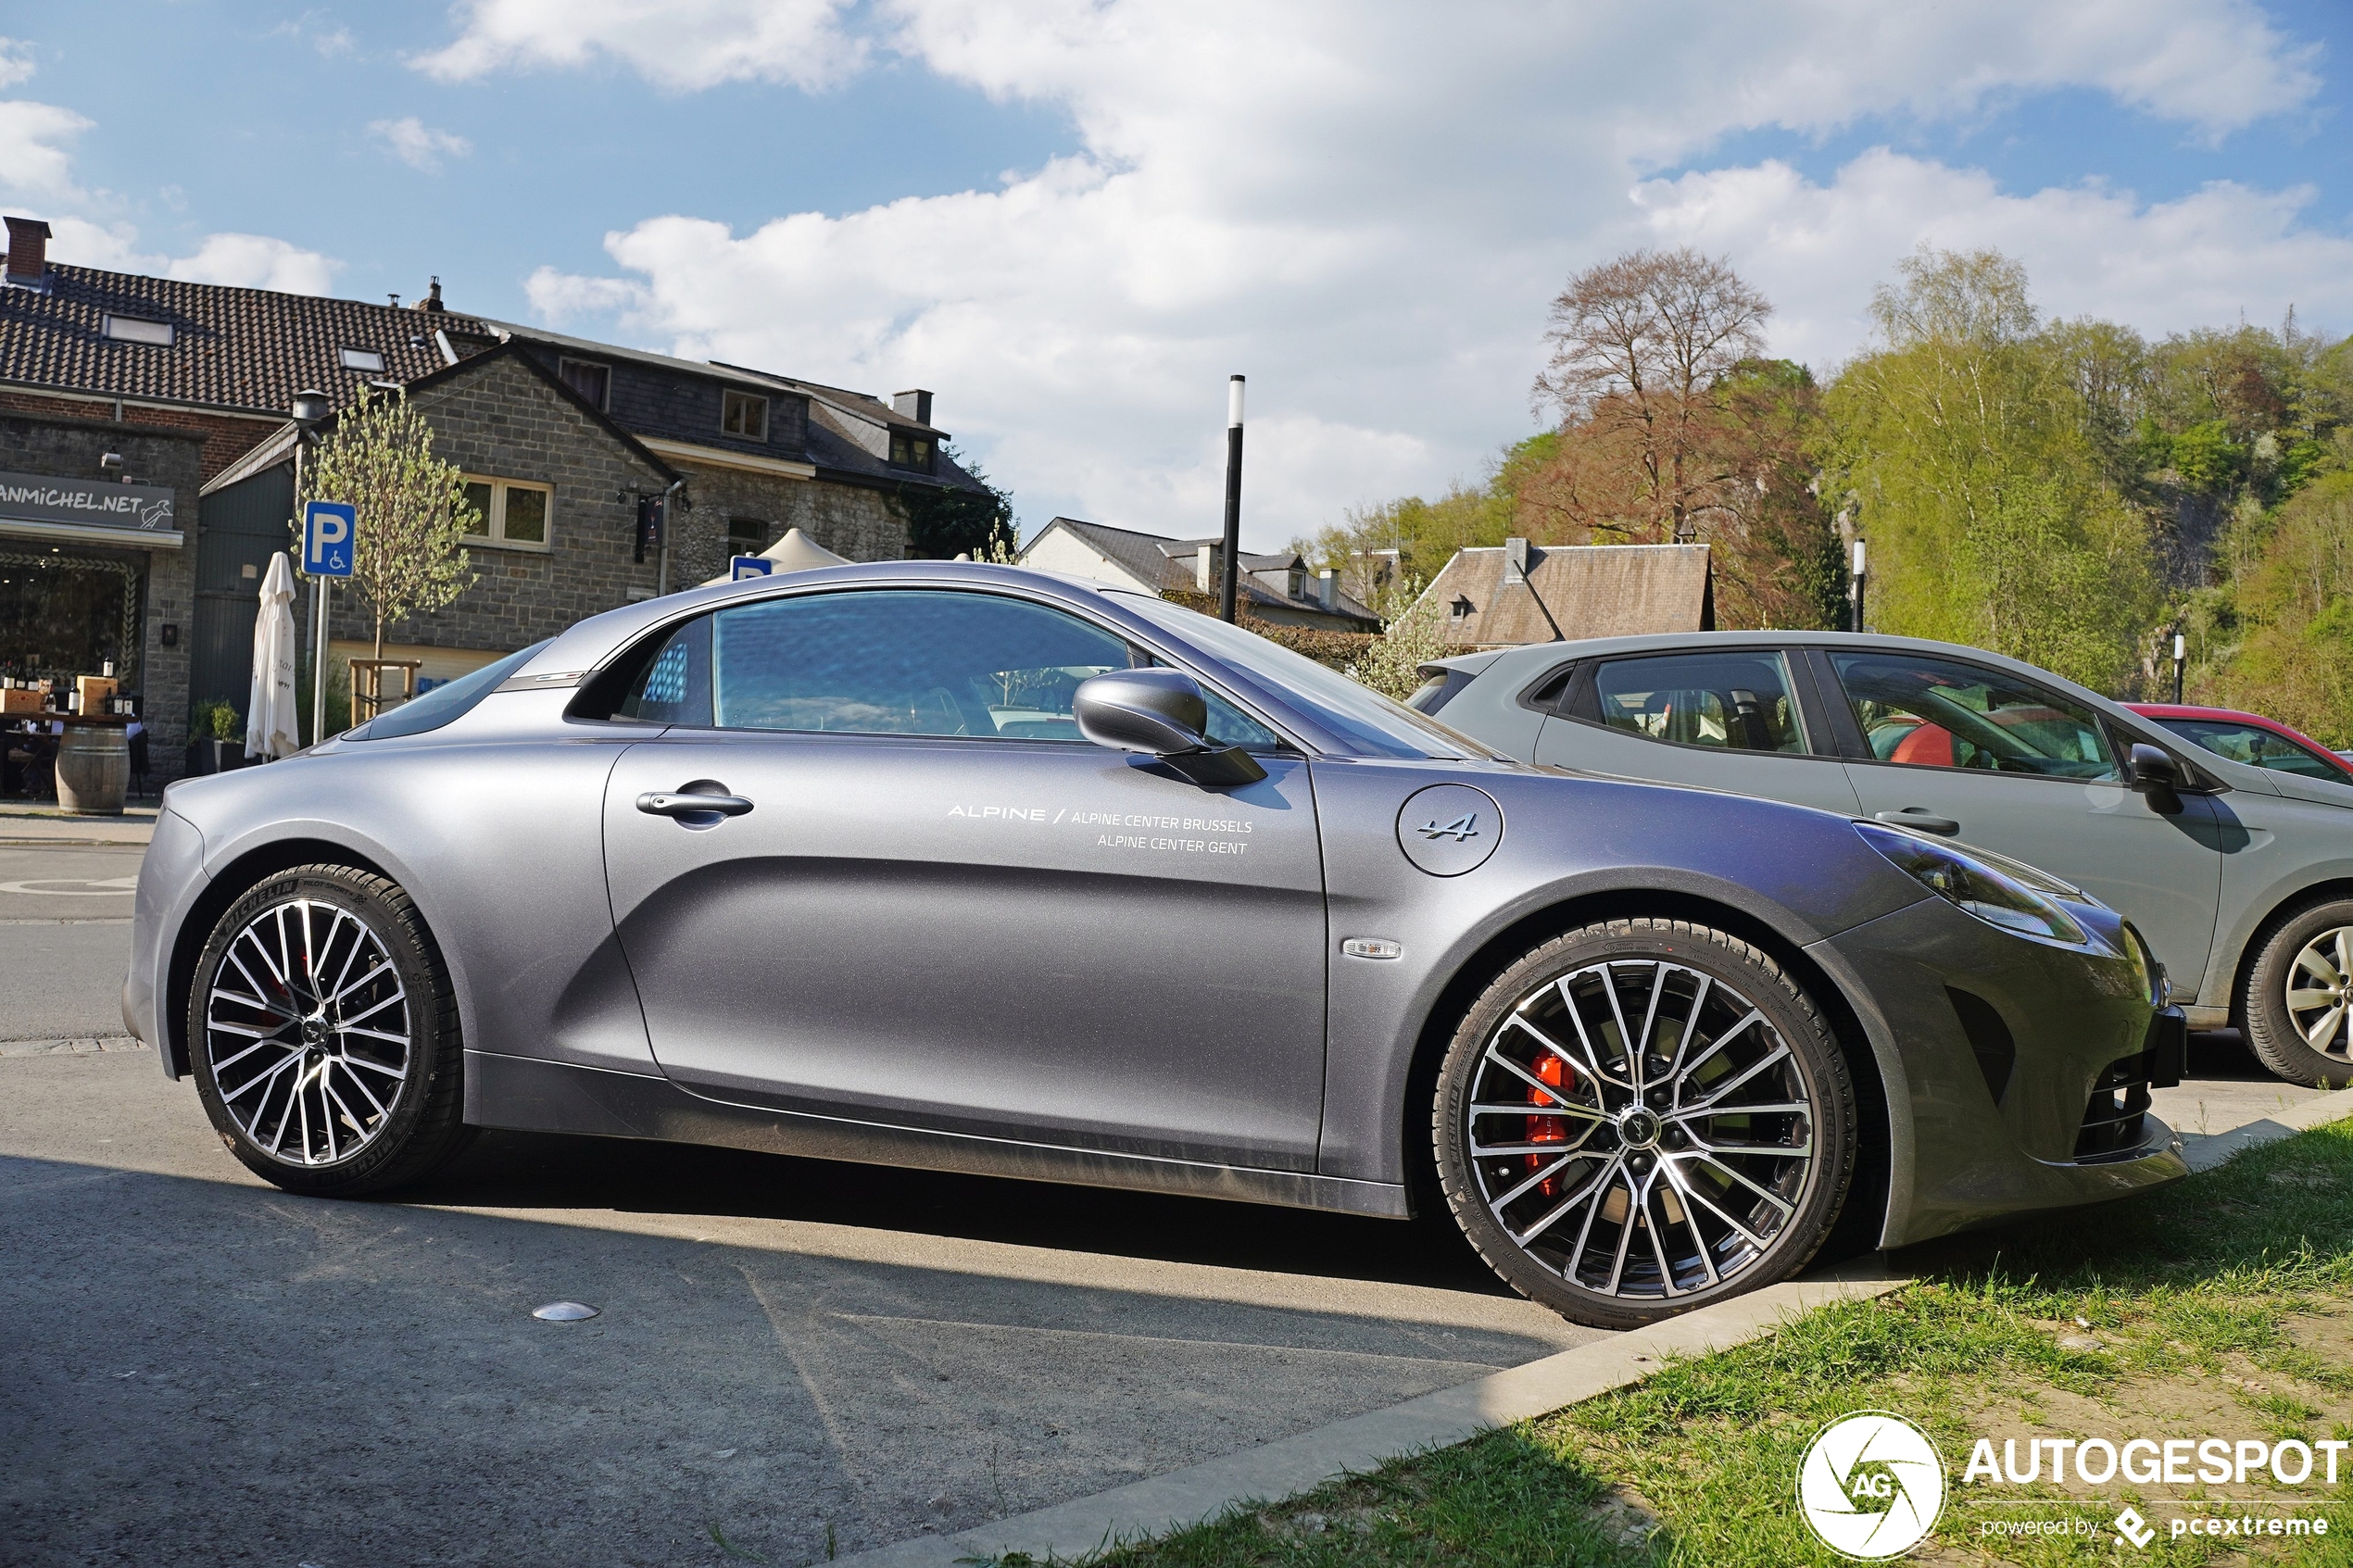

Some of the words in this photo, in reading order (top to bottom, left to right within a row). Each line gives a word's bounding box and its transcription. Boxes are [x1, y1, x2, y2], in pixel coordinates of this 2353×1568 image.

[311, 513, 348, 564] P
[948, 805, 1046, 821] ALPINE
[1071, 811, 1120, 825] ALPINE
[1125, 814, 1178, 829] CENTER
[1183, 819, 1252, 834] BRUSSELS
[1098, 834, 1146, 848] ALPINE
[1151, 838, 1203, 852] CENTER
[1208, 842, 1247, 854] GENT
[224, 881, 294, 934] MICHELIN
[326, 883, 348, 896] SPORT
[1448, 1087, 1460, 1164] MICHELIN
[1822, 1094, 1836, 1173] MICHELIN
